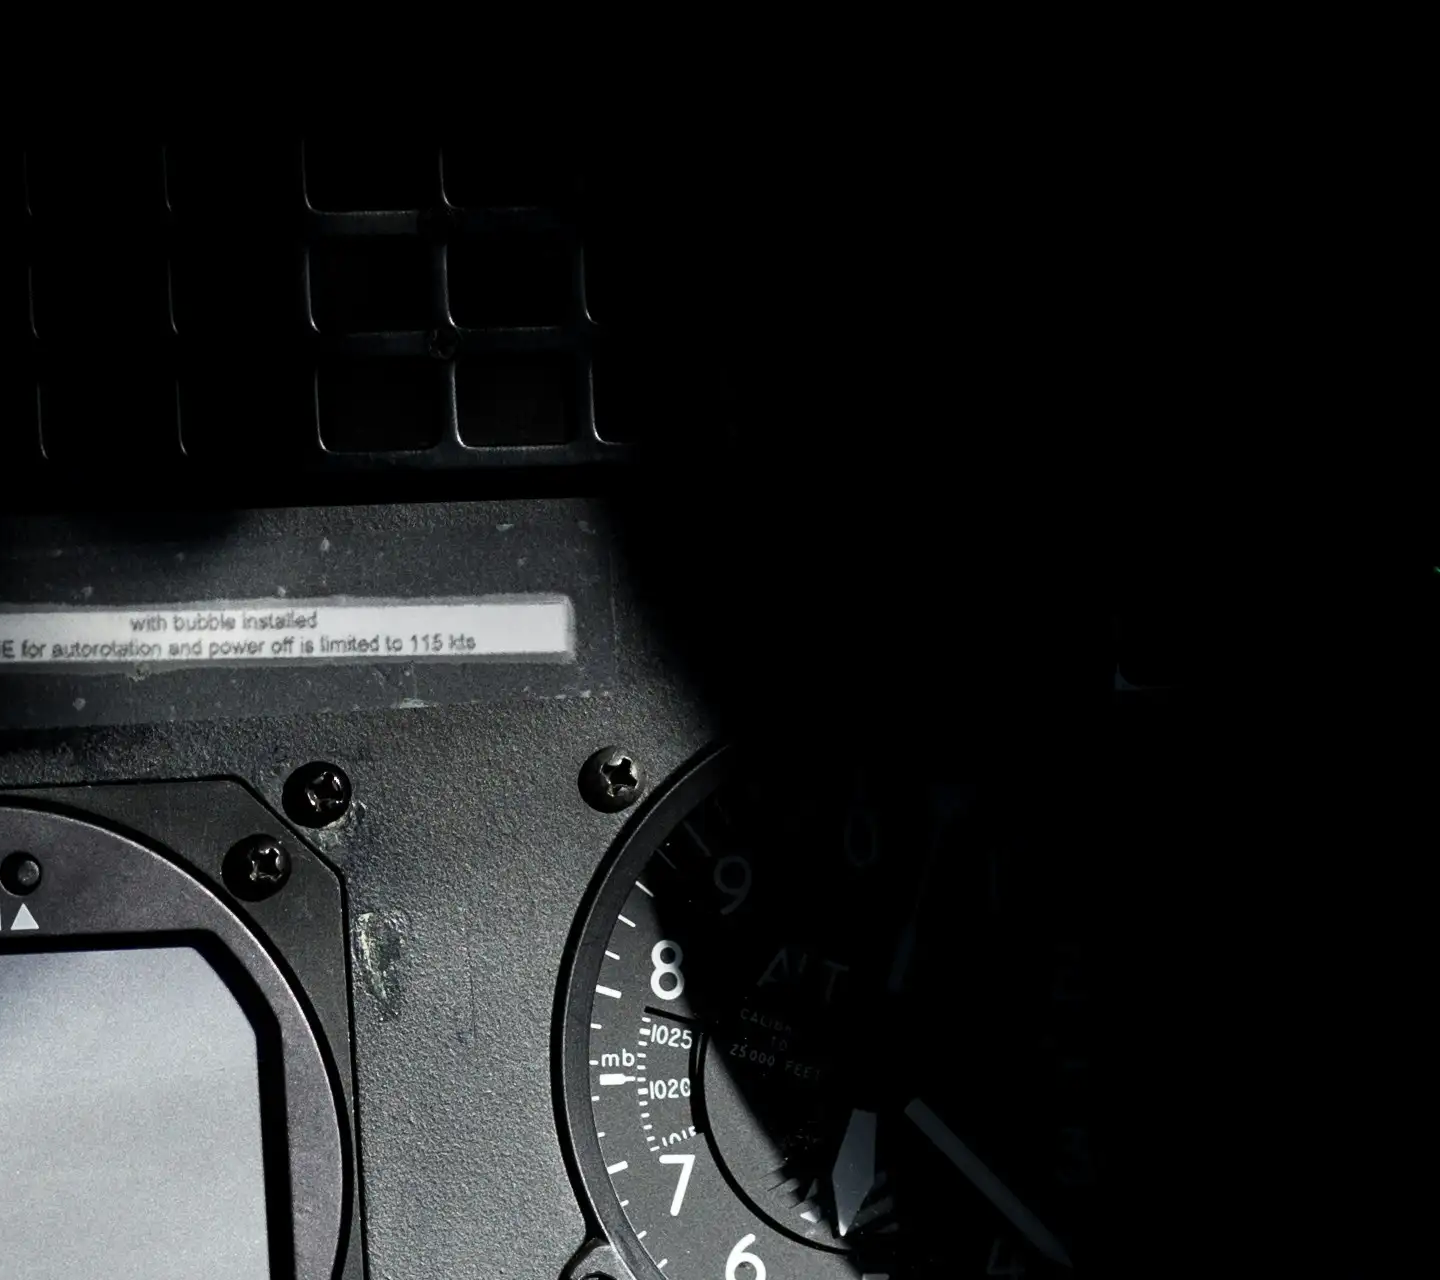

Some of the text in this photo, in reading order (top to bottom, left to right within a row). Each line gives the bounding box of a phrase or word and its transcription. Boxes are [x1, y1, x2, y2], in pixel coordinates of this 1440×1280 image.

[130, 610, 317, 632] with bubble installed
[22, 640, 46, 659] for
[52, 638, 161, 658] autorotation
[169, 638, 201, 657] and
[208, 640, 266, 659] power
[271, 636, 294, 655] off
[300, 636, 313, 654] is
[321, 634, 380, 653] limited
[386, 636, 402, 652] to
[411, 633, 442, 652] 115
[449, 633, 476, 651] kts
[650, 939, 683, 1000] 8
[651, 1024, 692, 1049] 1025
[601, 1049, 635, 1067] mb
[650, 1078, 691, 1099] 1020
[660, 1154, 695, 1216] 7
